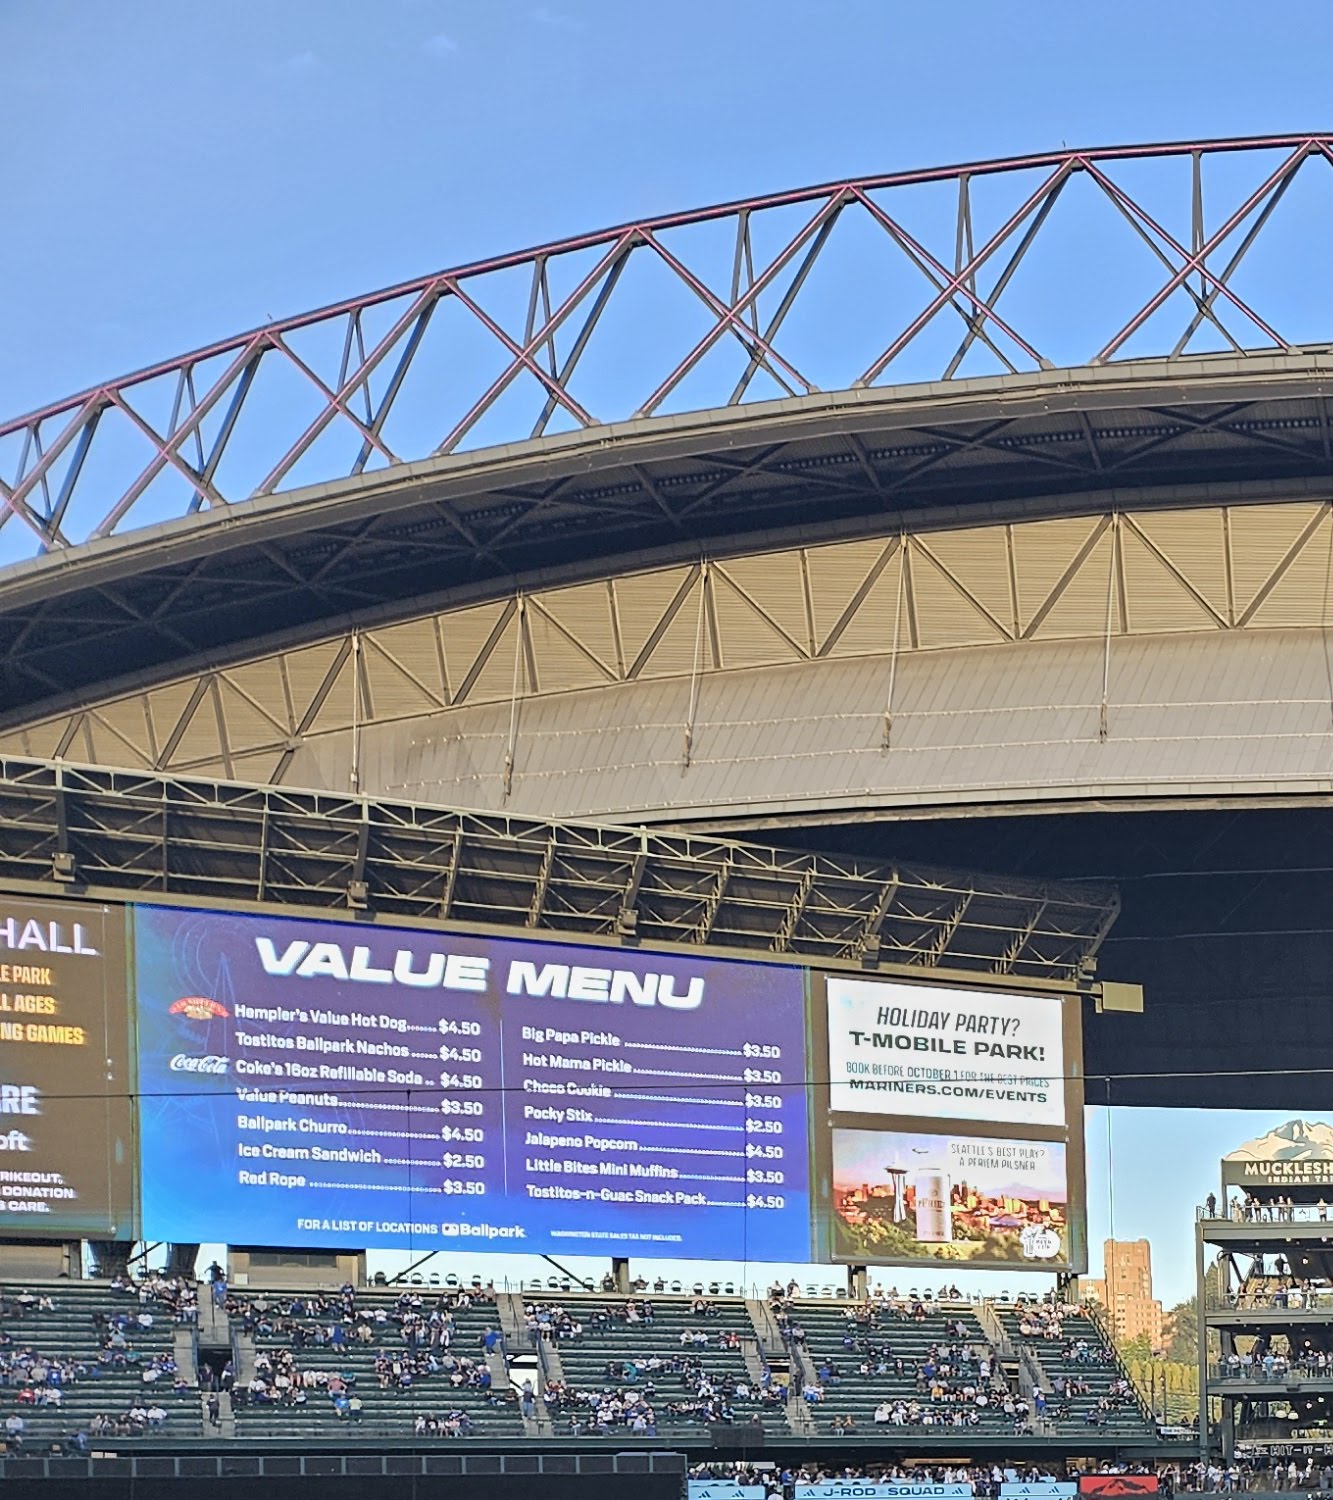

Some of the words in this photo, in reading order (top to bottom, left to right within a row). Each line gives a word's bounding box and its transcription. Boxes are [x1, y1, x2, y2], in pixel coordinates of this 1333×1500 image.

[13, 966, 52, 985] PARK
[254, 936, 490, 992] VALUE
[506, 959, 706, 1009] MENU
[15, 994, 57, 1014] AGES
[234, 1004, 308, 1023] Hempler's
[310, 1009, 349, 1026] Value
[351, 1012, 378, 1028] Hot
[379, 1015, 407, 1033] Dog
[438, 1018, 481, 1036] $4.50
[876, 1006, 950, 1030] HOLIDAY
[955, 1013, 1021, 1037] PARTY?
[26, 1024, 85, 1045] GAMES
[235, 1031, 294, 1049] Tostitos
[296, 1036, 355, 1054] Ballpark
[356, 1039, 410, 1058] Nachos
[439, 1044, 482, 1063] $4.50
[522, 1026, 545, 1043] Big
[545, 1028, 579, 1045] Papa
[581, 1030, 621, 1047] Pickle
[743, 1042, 781, 1059] $3.50
[849, 1030, 967, 1055] T-MOBILE
[974, 1041, 1046, 1062] PARK!
[235, 1059, 283, 1076] Coke's
[285, 1062, 319, 1078] 16oz
[319, 1065, 386, 1083] Refillable
[387, 1069, 423, 1086] Soda
[440, 1071, 483, 1089] $4.50
[522, 1053, 548, 1068] Hot
[550, 1054, 591, 1070] Mama
[592, 1058, 633, 1073] Pickle
[743, 1067, 782, 1084] $3.50
[846, 1061, 870, 1074] BOOK
[872, 1063, 904, 1078] BEFORE
[907, 1066, 951, 1081] OCTOBER
[236, 1087, 277, 1103] Value
[279, 1089, 338, 1107] Peanuts
[441, 1098, 484, 1116] $3.50
[523, 1079, 566, 1094] Choco
[566, 1081, 612, 1098] Cookie
[745, 1093, 782, 1109] $3.50
[849, 1079, 1048, 1103] MARINERS.COM/EVENTS
[237, 1115, 297, 1133] Ballpark
[299, 1118, 348, 1135] Churro
[441, 1125, 484, 1142] $4.50
[524, 1105, 565, 1123] Pocky
[566, 1107, 593, 1122] Stix
[745, 1118, 783, 1134] $2.50
[238, 1142, 261, 1158] Ice
[262, 1144, 309, 1160] Cream
[310, 1147, 382, 1163] Sandwich
[442, 1152, 485, 1169] $2.50
[525, 1132, 583, 1149] Jalapeno
[584, 1135, 639, 1151] Popcorn
[745, 1143, 784, 1159] $4.50
[238, 1170, 267, 1186] Red
[269, 1172, 306, 1188] Rope
[443, 1178, 485, 1195] $3.50
[526, 1158, 562, 1173] Little
[563, 1160, 598, 1175] Bites
[599, 1162, 628, 1176] Mini
[629, 1163, 679, 1179] Muffins
[746, 1168, 784, 1184] $3.50
[1267, 1176, 1310, 1184] INDIAN
[3, 1186, 75, 1199] DONATION
[526, 1184, 634, 1202] Tostitos-n-Guac
[635, 1190, 674, 1204] Snack
[675, 1191, 707, 1206] Pack
[746, 1193, 785, 1209] $4.50
[297, 1219, 321, 1231] FOR
[322, 1219, 332, 1231] A
[332, 1220, 358, 1232] LIST
[358, 1221, 374, 1232] OF
[376, 1222, 439, 1235] LOCATIONS
[460, 1223, 526, 1239] Ballpark
[823, 1487, 877, 1497] J-ROD
[887, 1486, 945, 1496] SQUAD
